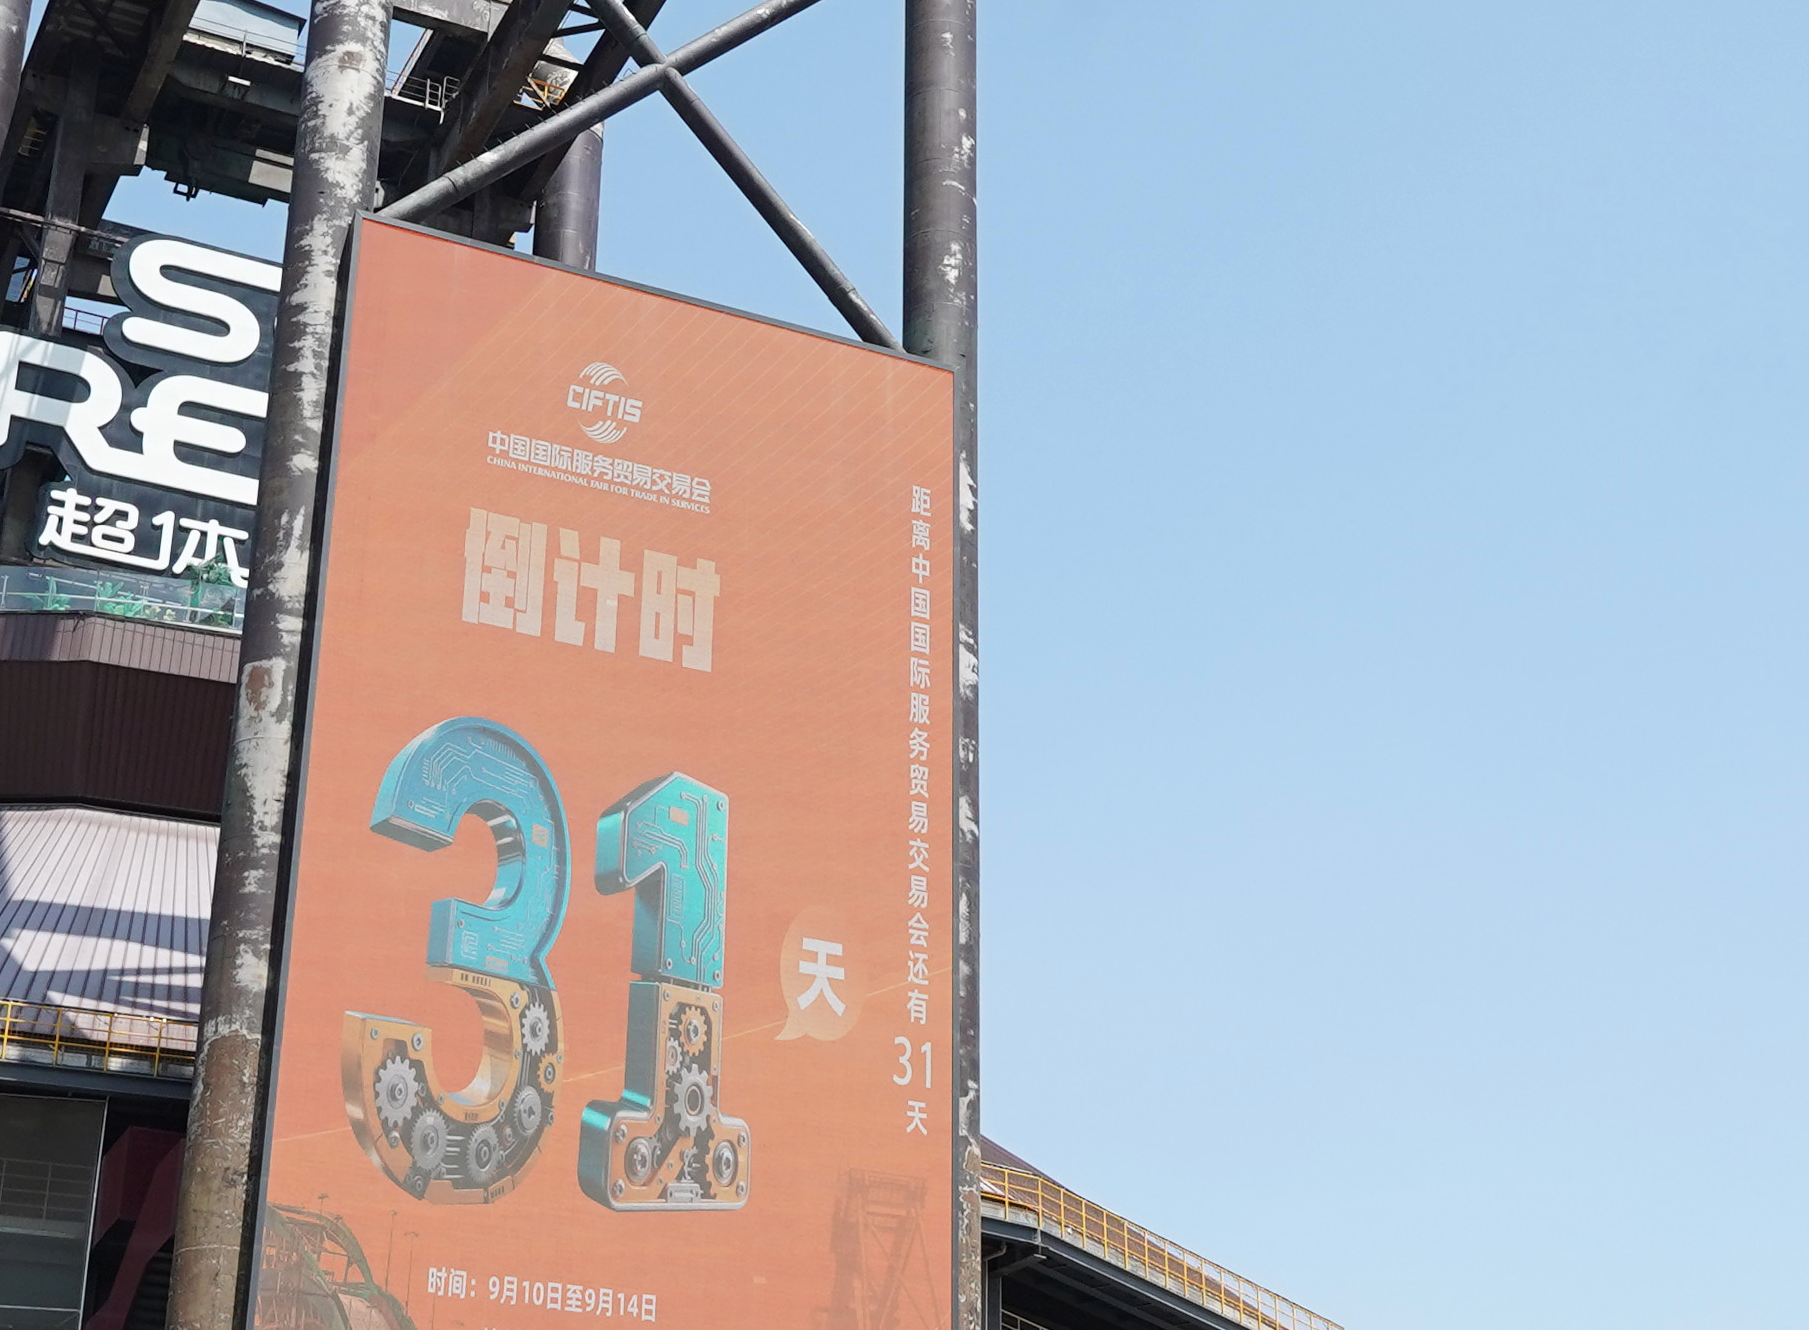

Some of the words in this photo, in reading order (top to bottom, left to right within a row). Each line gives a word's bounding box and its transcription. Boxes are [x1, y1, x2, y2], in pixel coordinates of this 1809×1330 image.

[566, 383, 643, 423] CIFTIS
[486, 455, 517, 471] CHINA
[518, 462, 589, 488] INTERNATIONAL
[590, 478, 610, 492] FAIR
[610, 484, 629, 496] FOR
[630, 488, 658, 504] TRADE
[659, 494, 670, 505] IN
[670, 496, 711, 515] SERVICES
[487, 430, 712, 504] 中国国际服务贸易交易会
[461, 507, 721, 673] 倒计时
